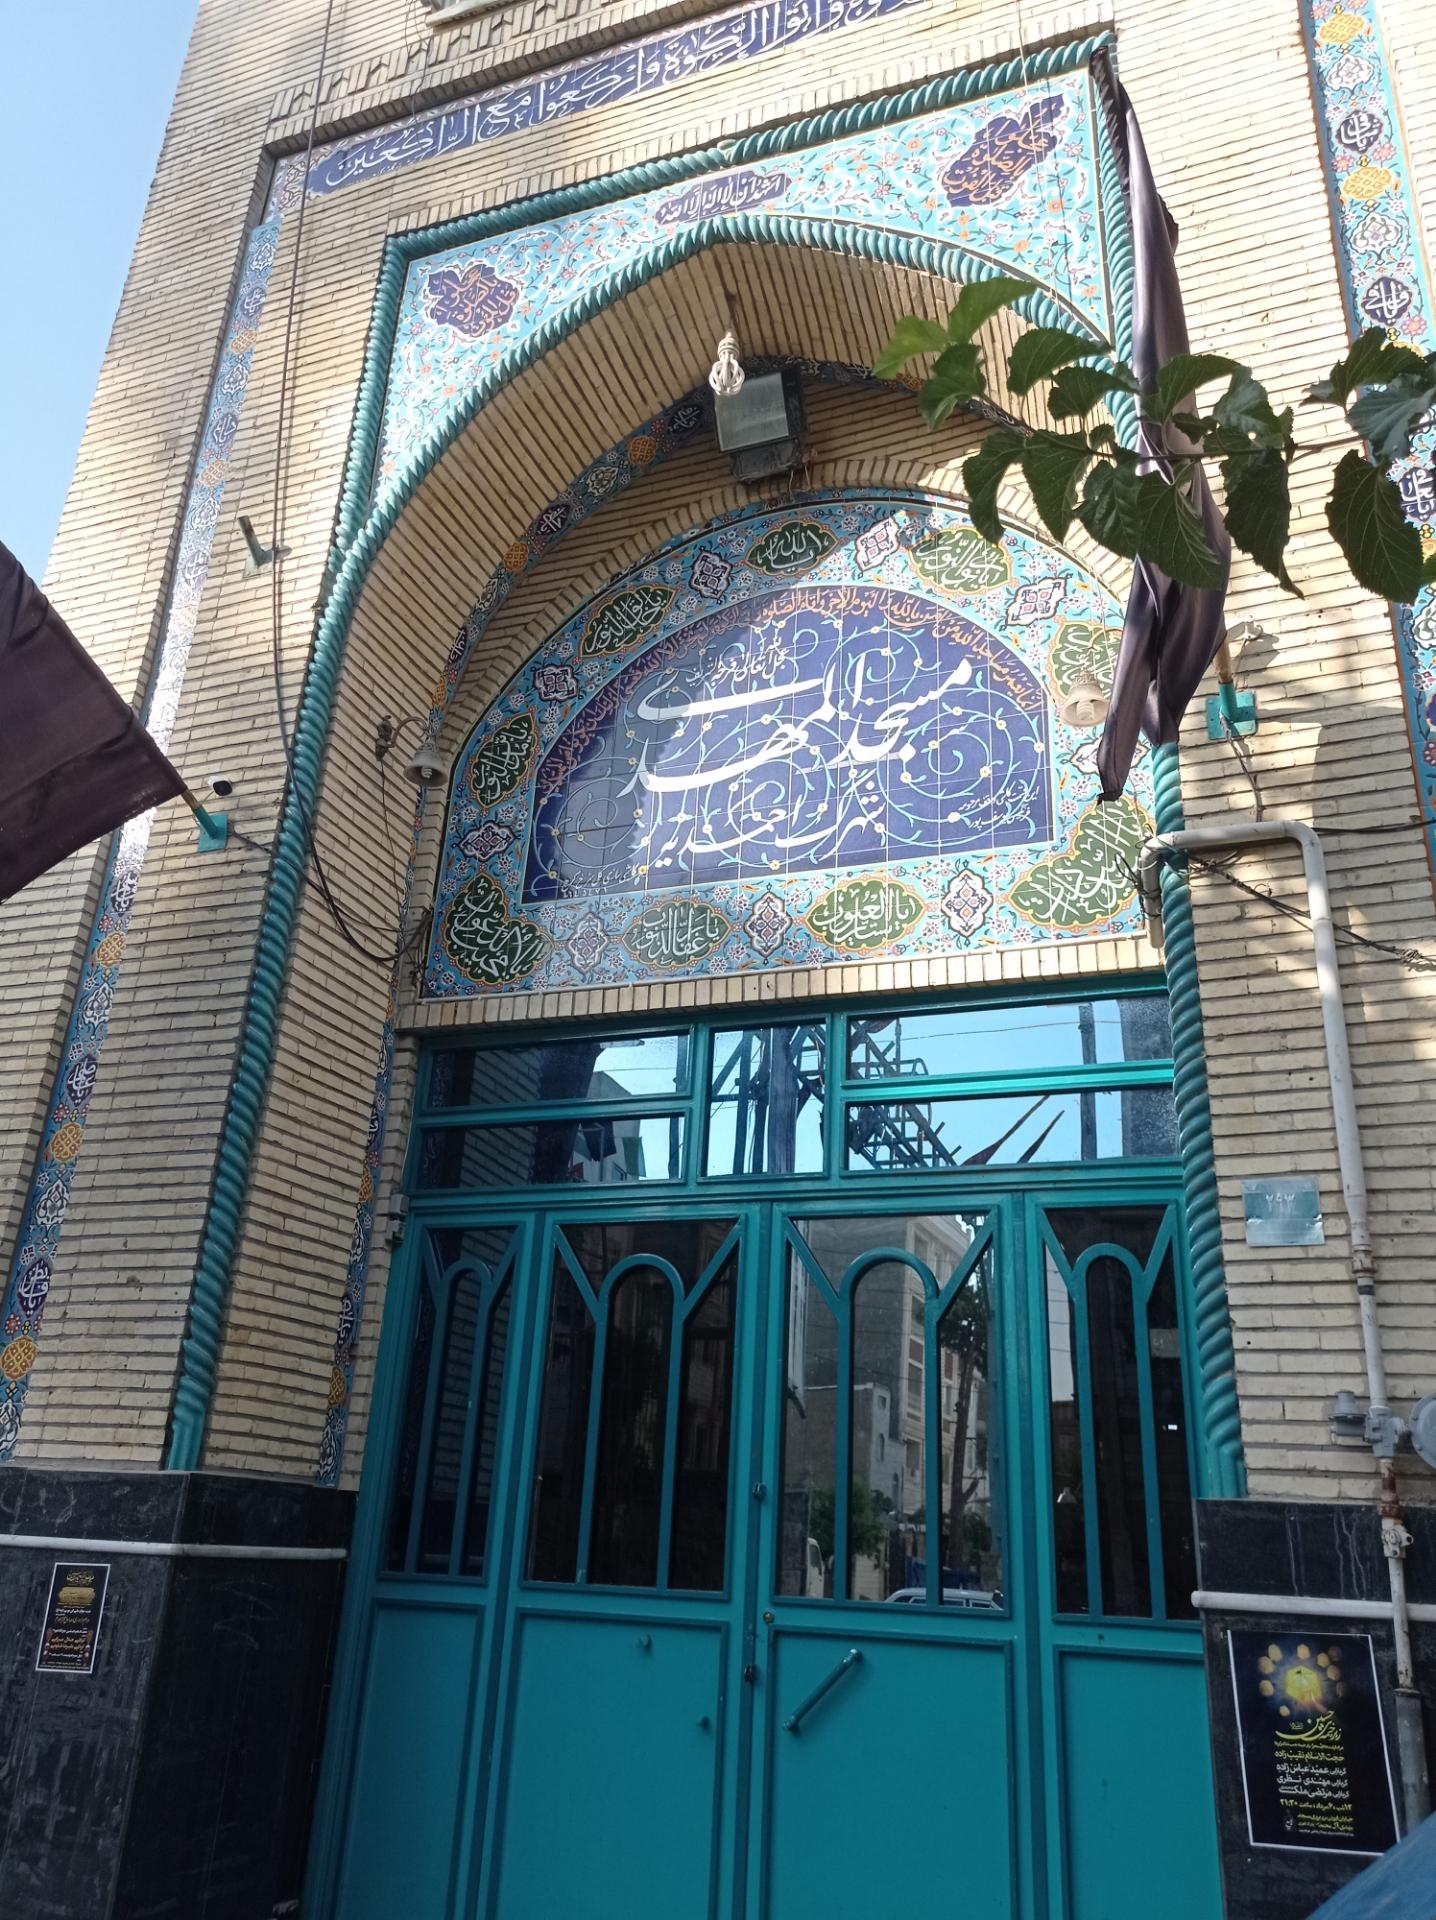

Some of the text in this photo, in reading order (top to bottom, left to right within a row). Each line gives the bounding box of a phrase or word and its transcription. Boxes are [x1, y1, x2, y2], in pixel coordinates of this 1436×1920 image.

[617, 652, 867, 798] المهدی
[808, 659, 973, 770] مسجد
[775, 769, 885, 861] شهرک
